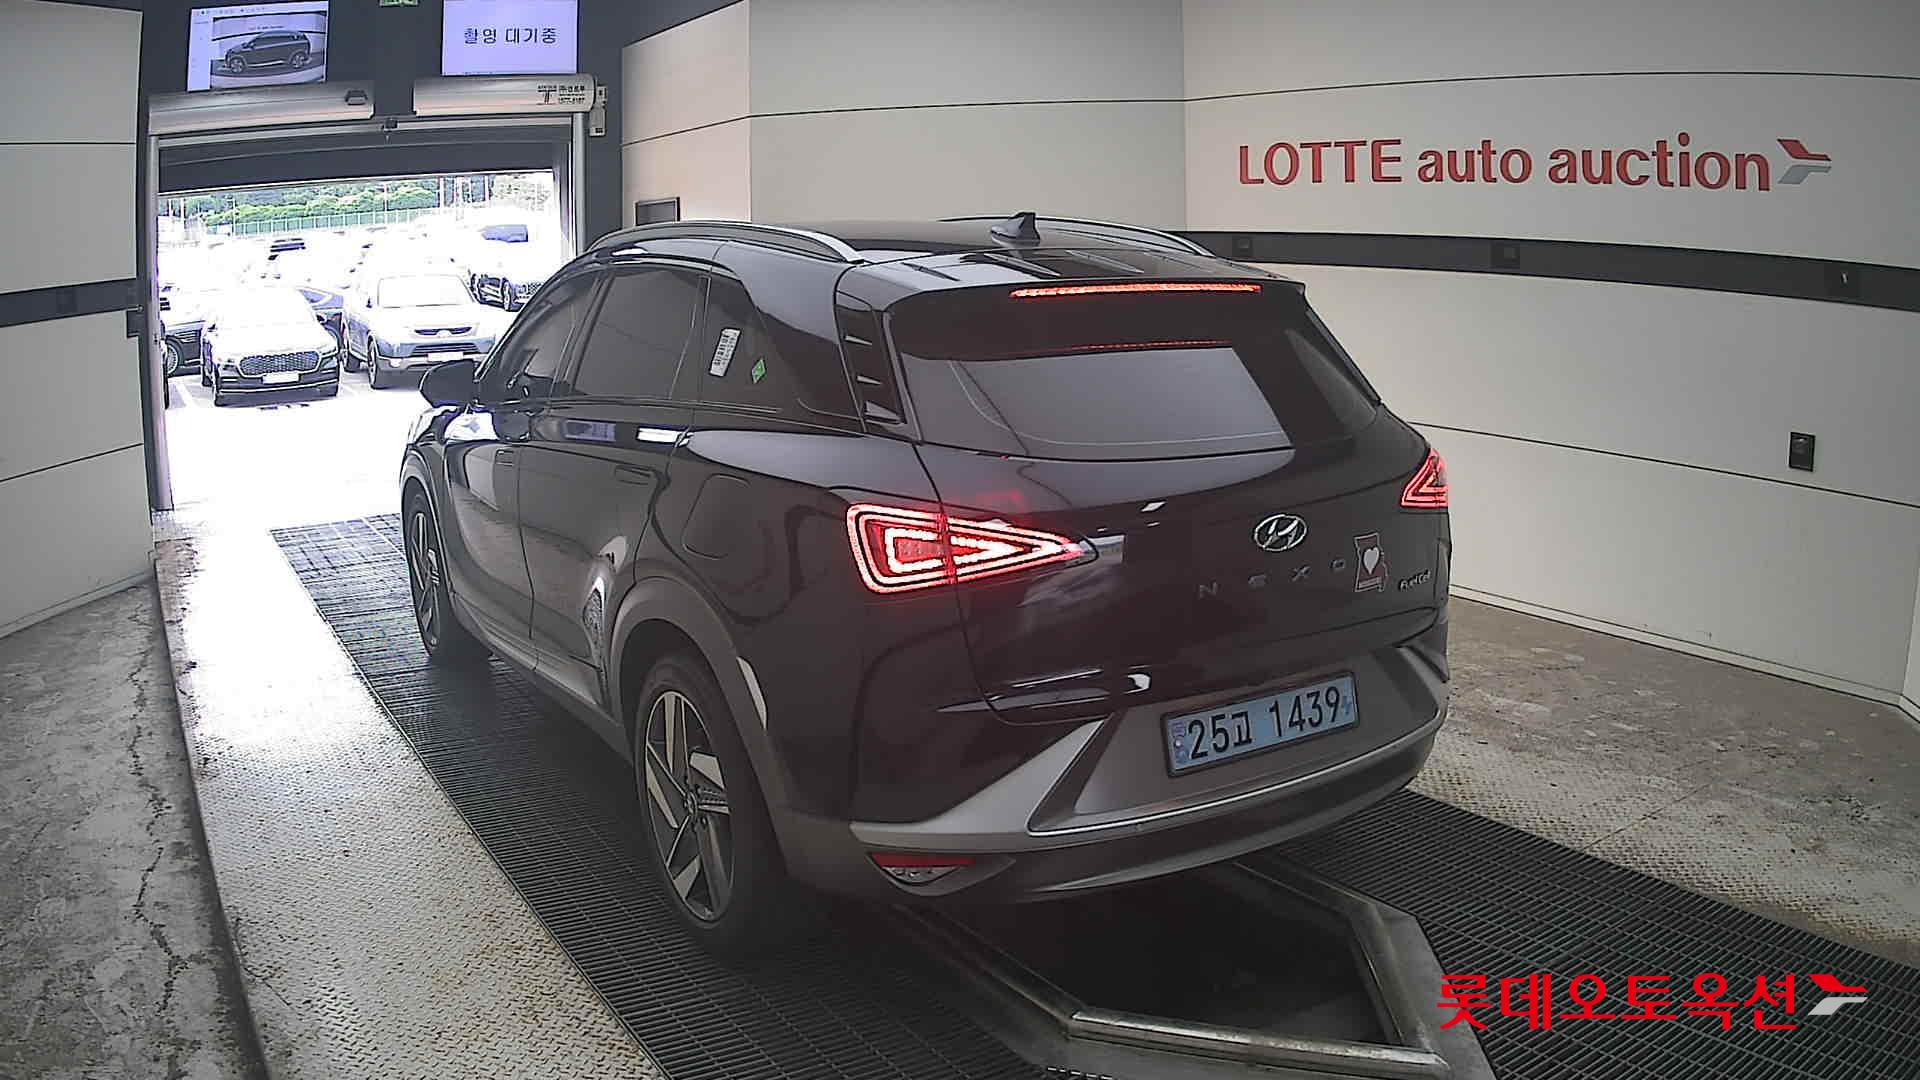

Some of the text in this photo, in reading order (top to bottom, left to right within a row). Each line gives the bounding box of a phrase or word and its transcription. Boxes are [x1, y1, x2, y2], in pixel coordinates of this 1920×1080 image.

[505, 27, 558, 44] 대기중
[1238, 131, 1771, 192] LOTTE auto auction
[1269, 686, 1341, 737] 1439
